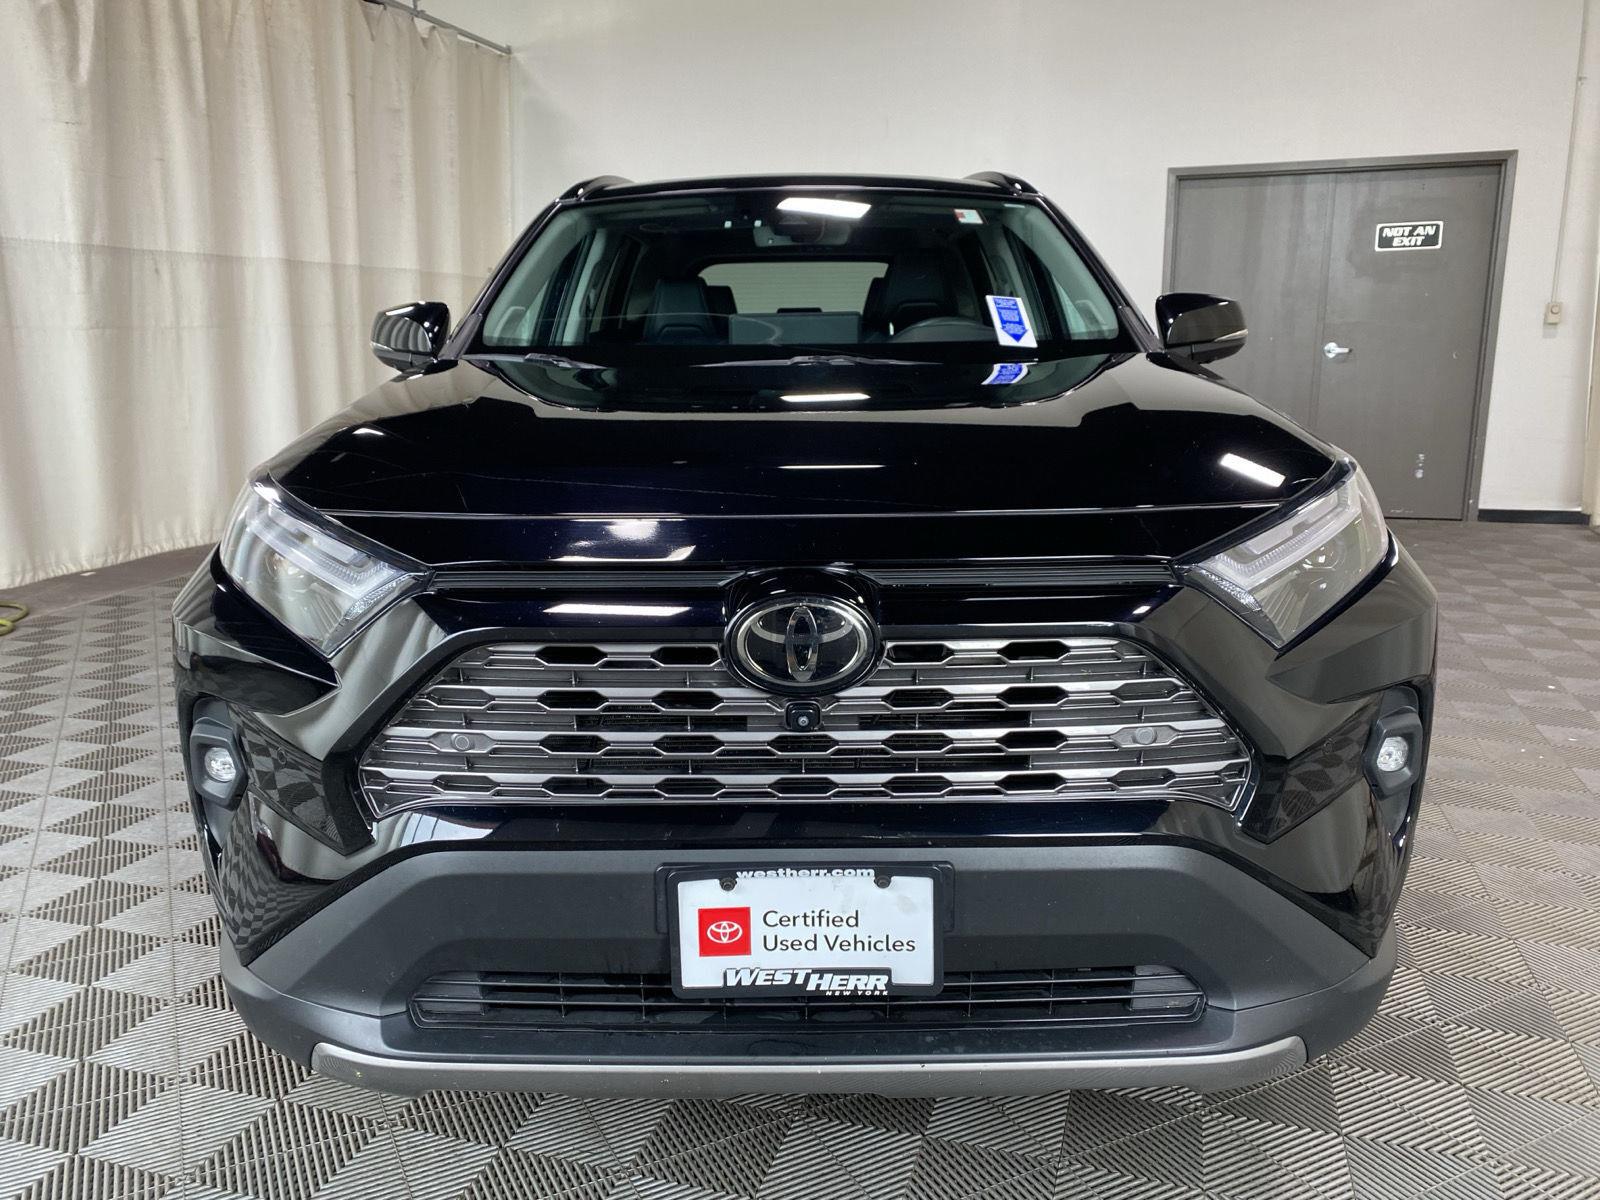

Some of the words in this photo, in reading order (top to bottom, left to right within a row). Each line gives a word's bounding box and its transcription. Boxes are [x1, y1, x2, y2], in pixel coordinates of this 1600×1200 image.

[1382, 227, 1413, 238] NOT
[1413, 225, 1437, 236] AN
[1392, 236, 1425, 247] EXIT
[736, 868, 876, 879] westherr.com
[763, 909, 860, 928] Certified
[763, 934, 818, 952] Used
[824, 934, 916, 952] Vehicles
